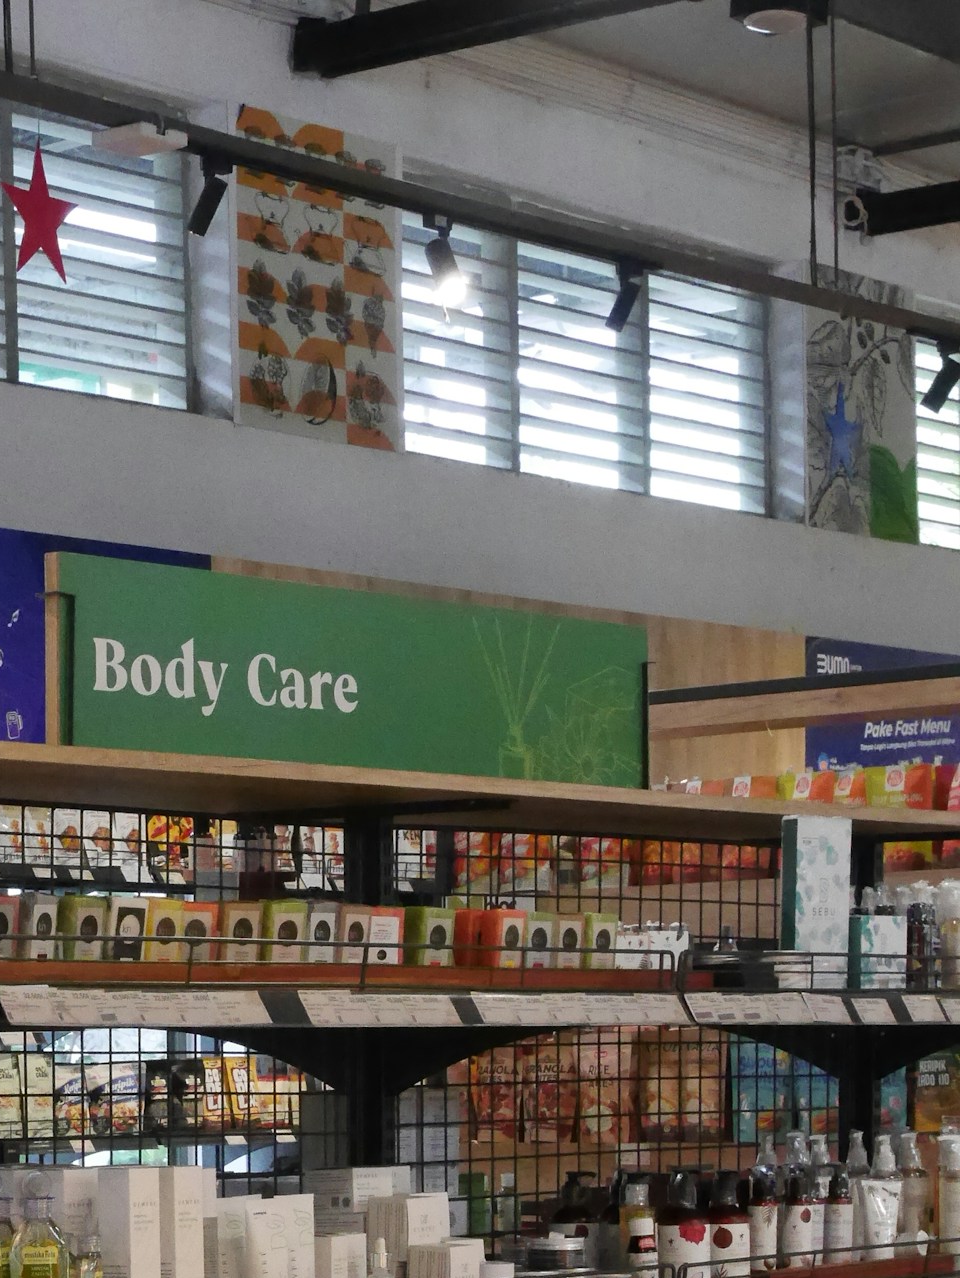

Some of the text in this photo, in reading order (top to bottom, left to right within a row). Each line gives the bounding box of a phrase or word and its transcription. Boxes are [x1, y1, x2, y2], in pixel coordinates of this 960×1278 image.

[93, 637, 359, 716] Body Care
[864, 718, 951, 739] Pake Fast Menu
